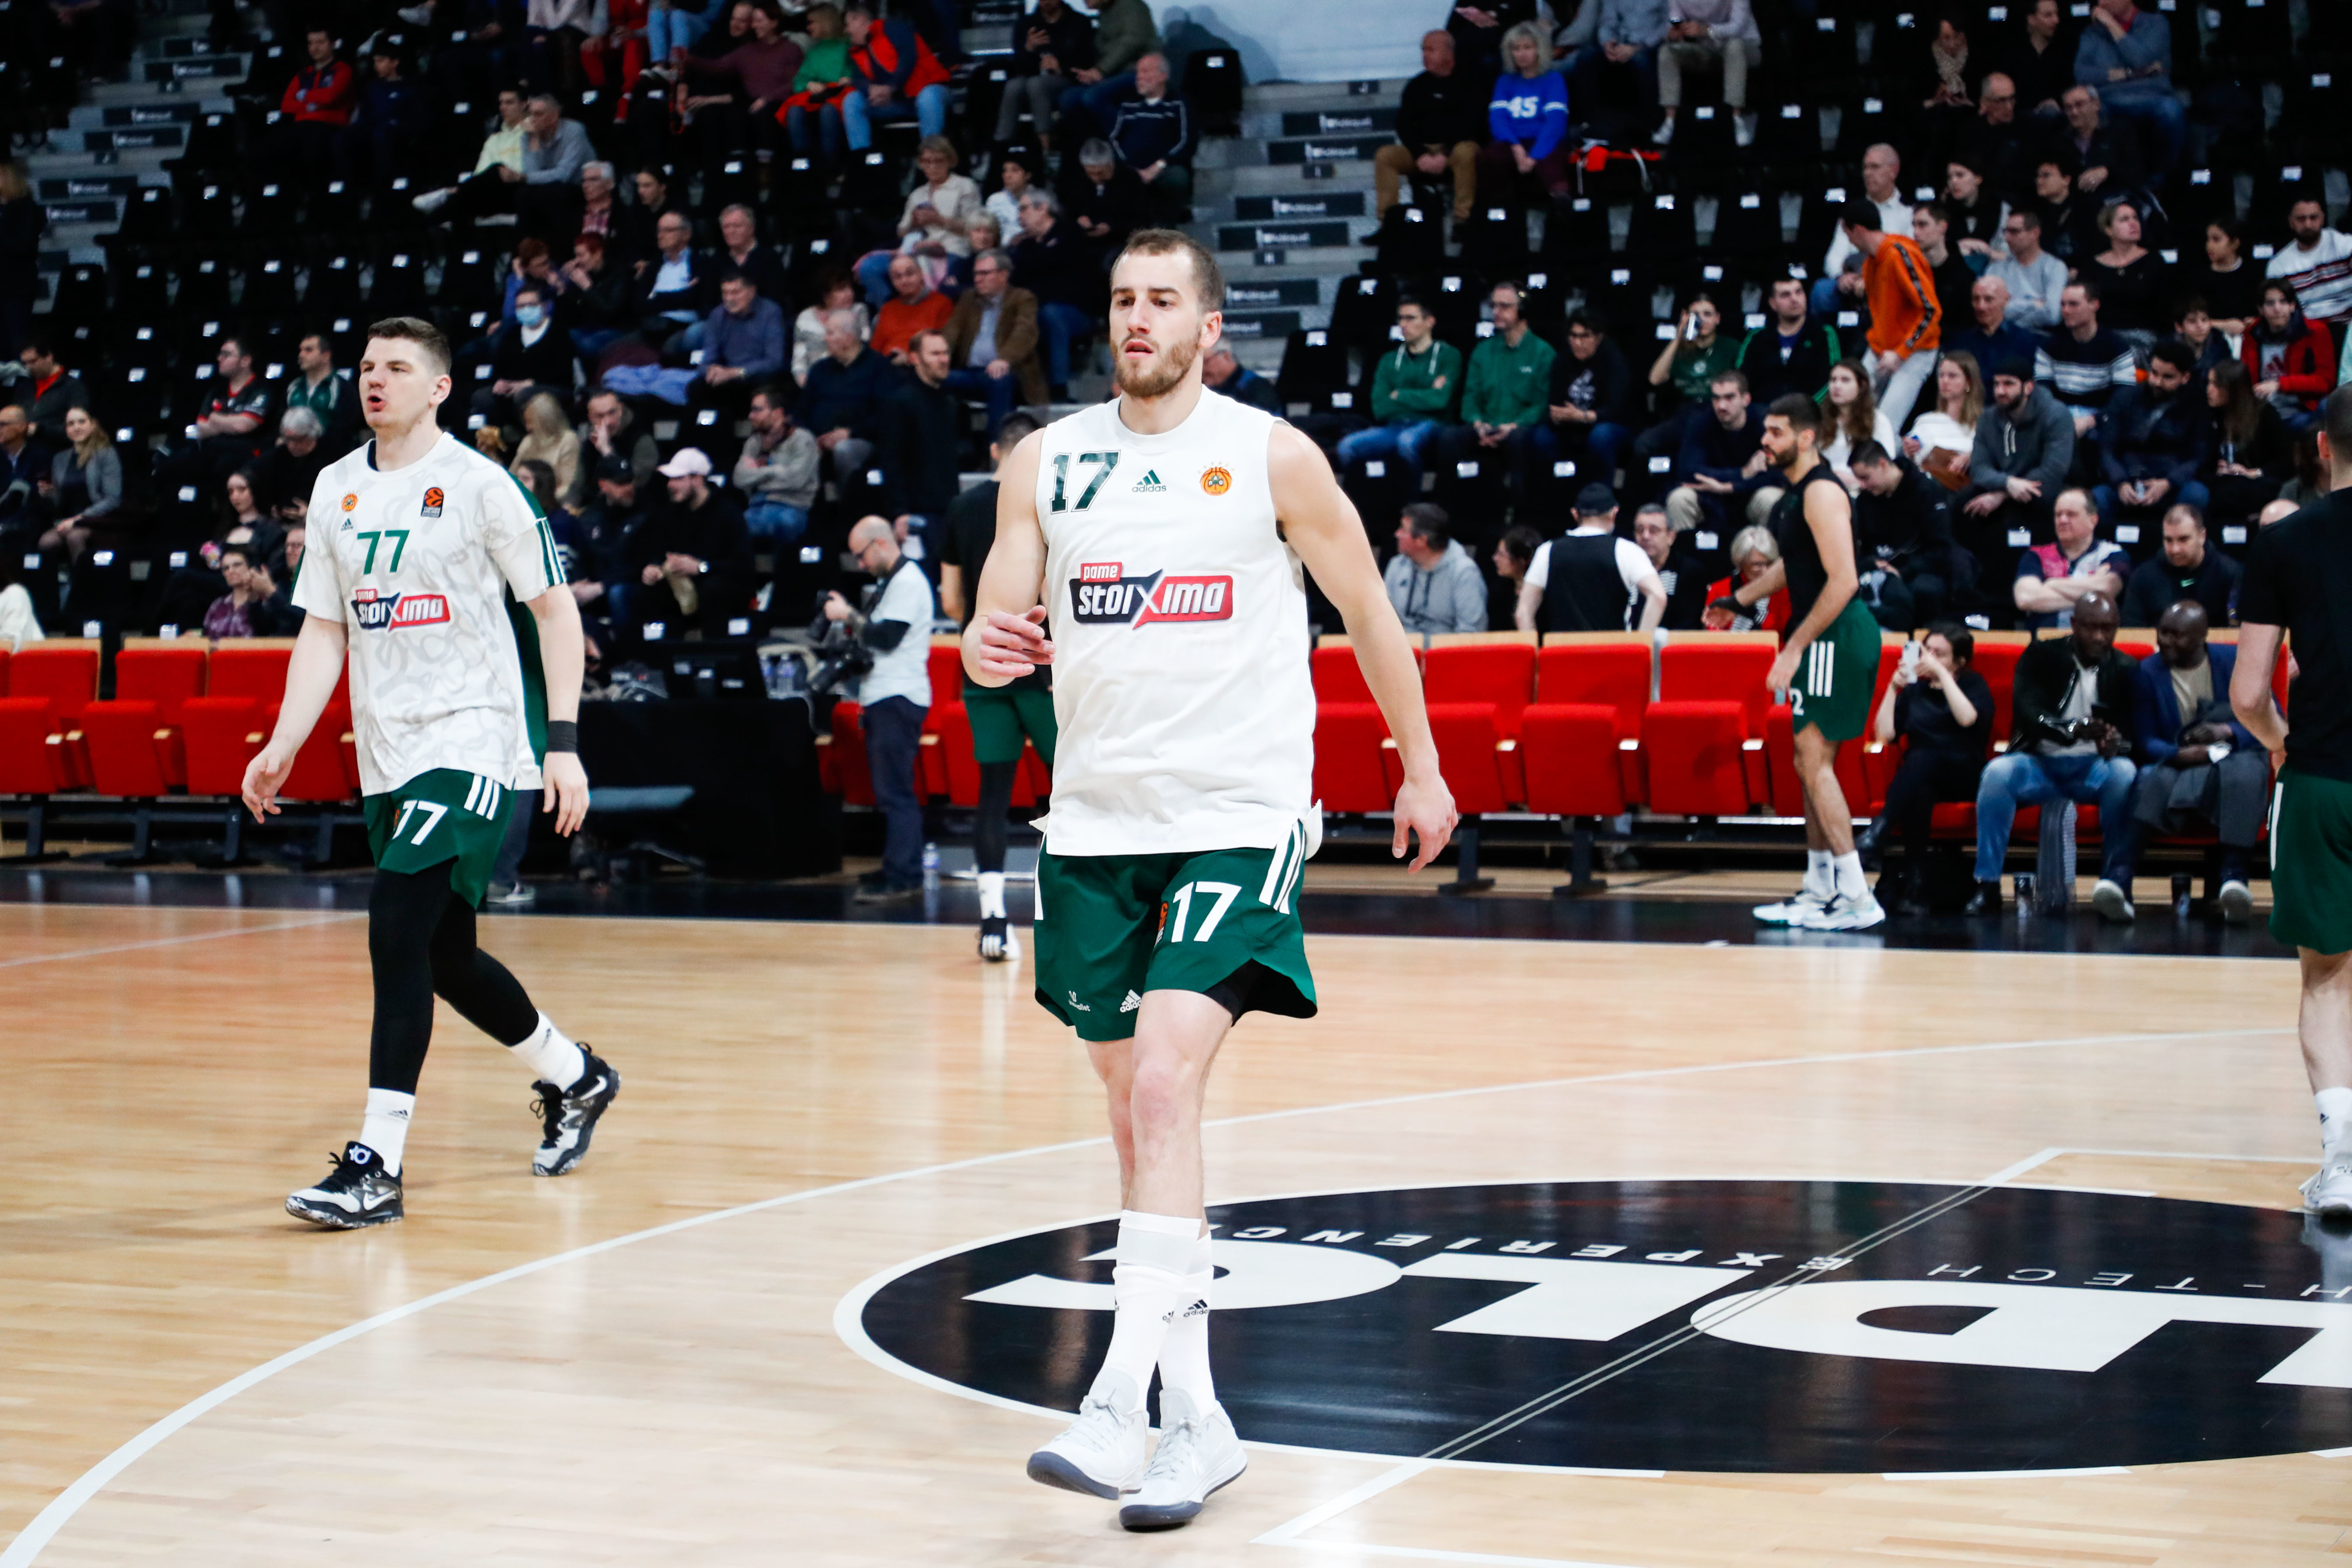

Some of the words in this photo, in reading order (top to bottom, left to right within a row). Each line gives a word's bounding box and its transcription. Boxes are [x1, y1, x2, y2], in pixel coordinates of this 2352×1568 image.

[1508, 96, 1539, 118] 45
[1050, 450, 1121, 514] 17
[1133, 482, 1167, 493] adidas
[357, 530, 410, 575] 77
[1083, 565, 1119, 580] pame
[1171, 881, 1242, 943] 17
[1119, 1000, 1141, 1013] adida
